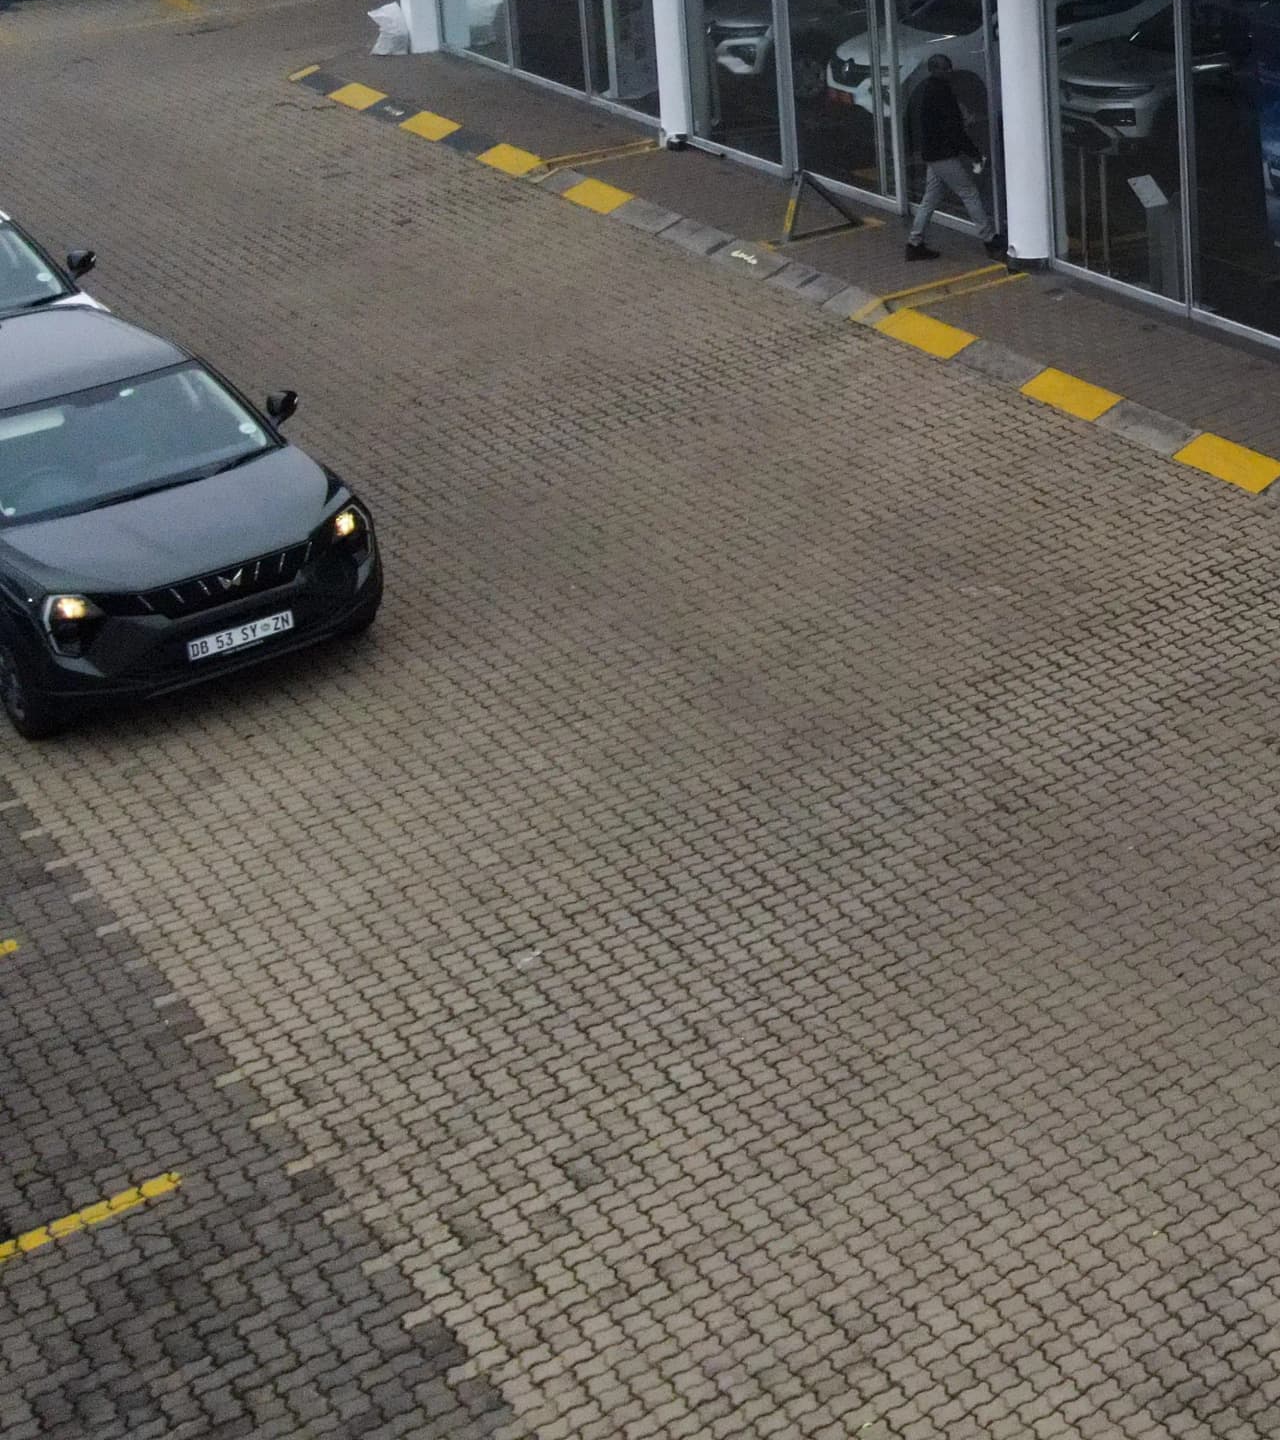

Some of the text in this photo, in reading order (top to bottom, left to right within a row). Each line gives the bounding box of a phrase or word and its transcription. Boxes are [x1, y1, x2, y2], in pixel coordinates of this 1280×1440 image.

[216, 632, 234, 649] 53
[241, 624, 258, 640] SY
[272, 613, 290, 631] ZN
